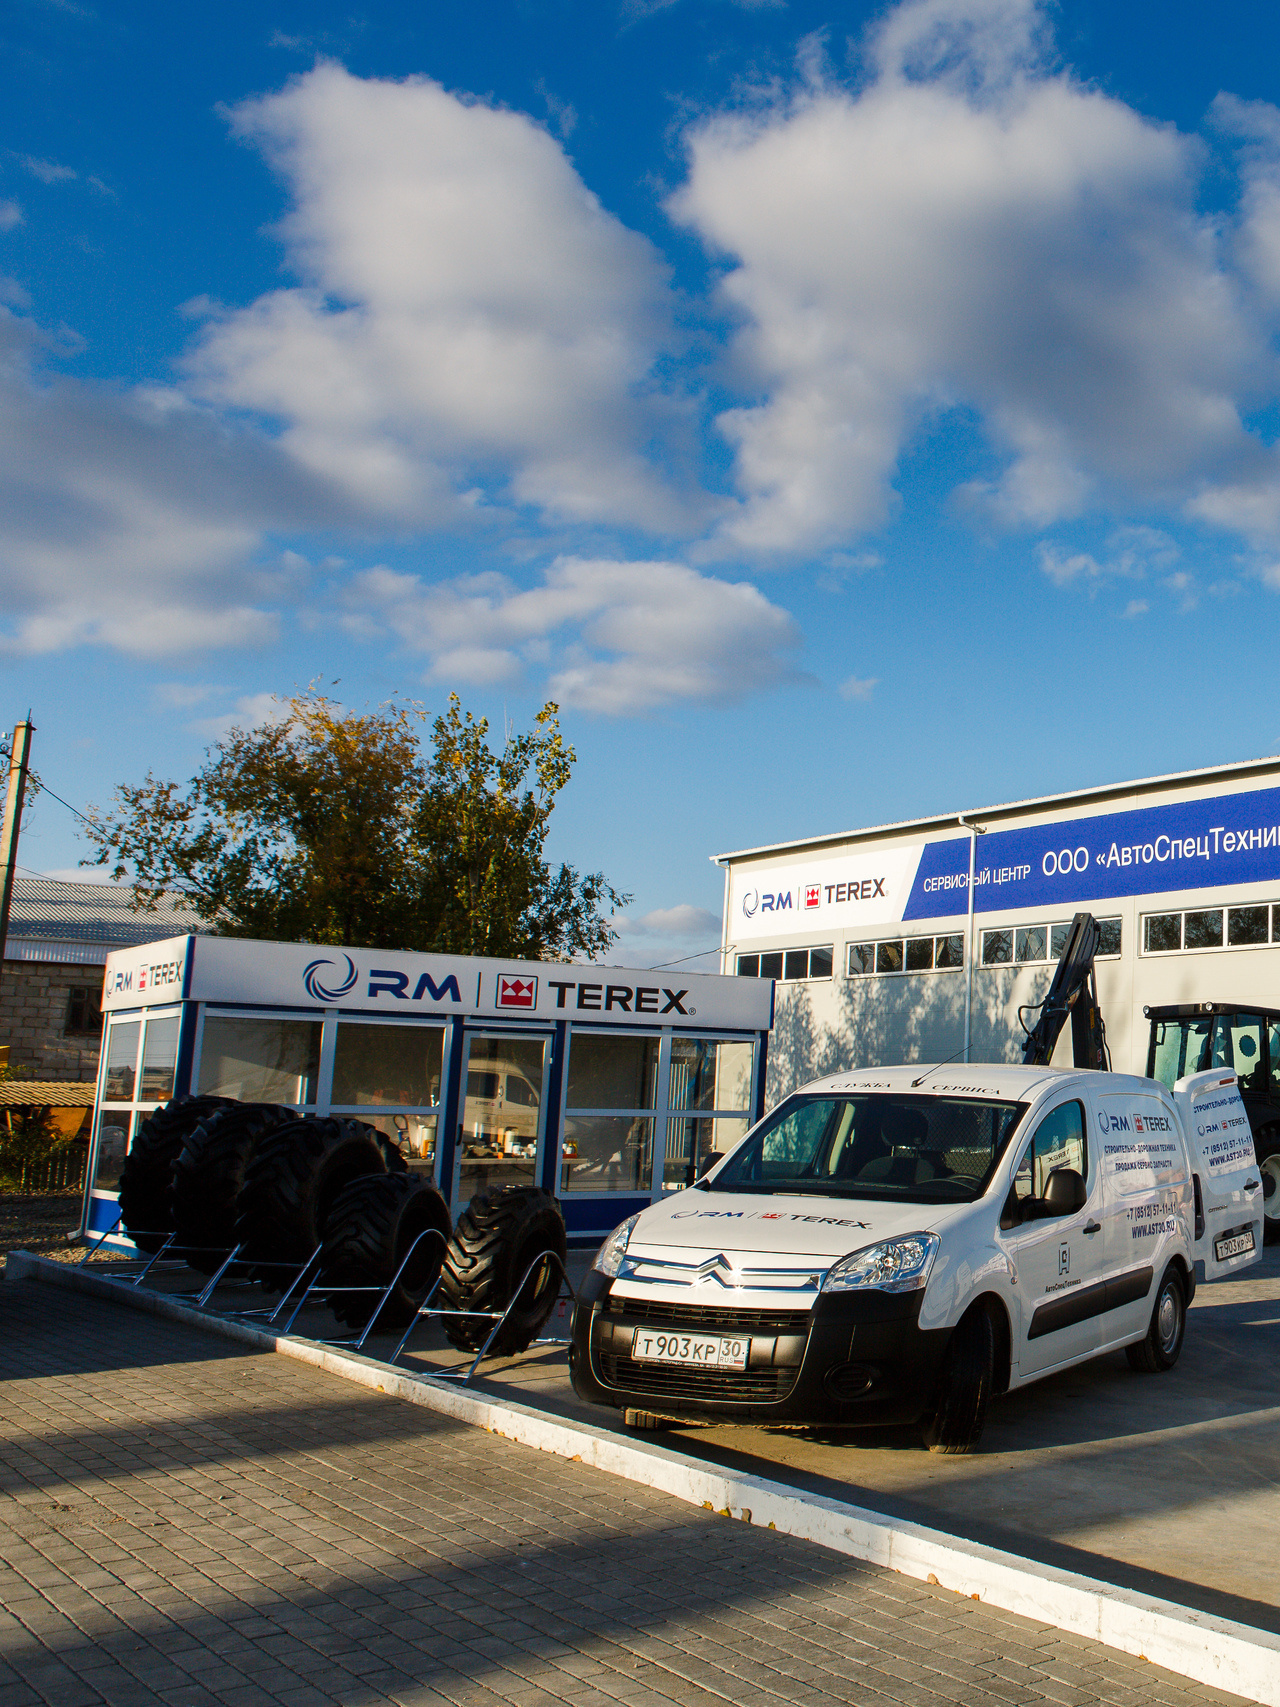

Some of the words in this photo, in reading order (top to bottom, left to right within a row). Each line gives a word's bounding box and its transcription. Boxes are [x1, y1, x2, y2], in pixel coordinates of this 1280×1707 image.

[993, 864, 1031, 885] ЦЕНТР
[1042, 846, 1090, 877] ООО
[761, 891, 793, 912] RM
[115, 971, 133, 993] RM
[149, 960, 183, 986] TEREX
[367, 968, 463, 1003] RM
[932, 1084, 1001, 1095] СЕРВИСА
[1110, 1116, 1130, 1131] RM
[1143, 1117, 1171, 1131] TEREX
[1206, 1123, 1219, 1134] RM
[1228, 1116, 1247, 1128] TEREX
[1104, 1145, 1160, 1153] СТРОИТЕЛЬНО-ДОРОЖНАЯ
[1160, 1144, 1176, 1152] ТЕХНИКА
[1202, 1146, 1209, 1155] +7
[1210, 1141, 1229, 1155] (8512)
[1229, 1135, 1252, 1148] 57-11-11
[1115, 1162, 1137, 1171] ПРОДАЖА
[1137, 1161, 1152, 1169] СЕРВИС
[1153, 1160, 1172, 1168] ЗАПЧАСТИ
[1208, 1148, 1251, 1167] WWW.AST30.RU
[1127, 1208, 1134, 1220] +7
[1134, 1204, 1153, 1221] (8512)
[1153, 1202, 1176, 1216] 57-11-11
[1132, 1220, 1175, 1239] WWW.AST30.RU
[721, 1340, 741, 1357] 30
[719, 1356, 733, 1364] RUS
